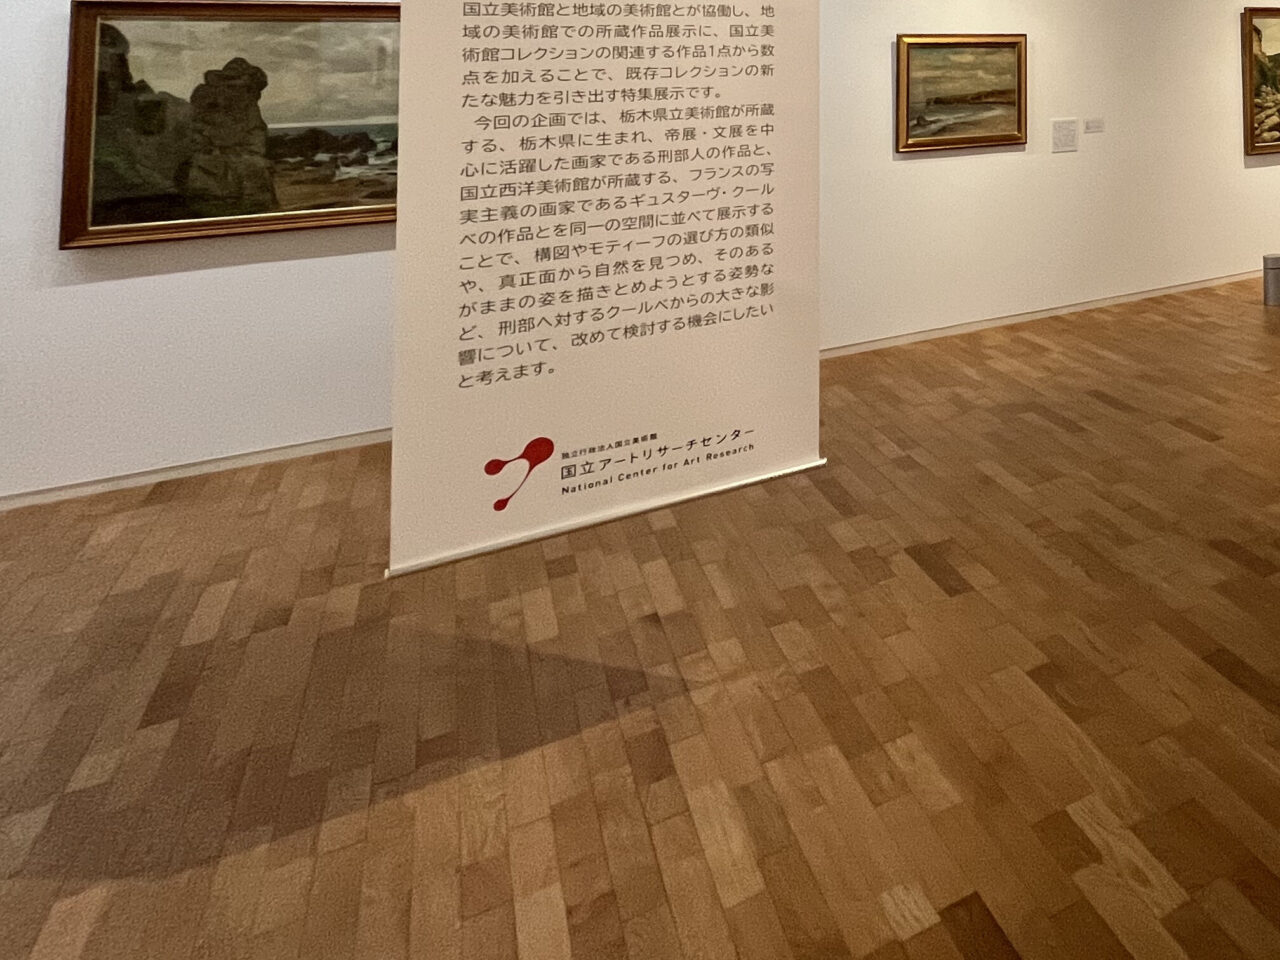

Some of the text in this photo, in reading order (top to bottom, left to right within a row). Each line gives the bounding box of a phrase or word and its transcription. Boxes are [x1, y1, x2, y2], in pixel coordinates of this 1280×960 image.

[463, 2, 775, 18] 国立美術館と地域の美術館とが協働し、地
[462, 24, 775, 39] 域の美術館での所蔵作品展示に、国立美
[462, 44, 775, 63] 術館コレクションの関連する作品1点から数
[461, 63, 775, 85] 点を加えることで、既存コレクションの新
[461, 86, 721, 108] たな魅力を引き出す特集展示です。
[474, 104, 775, 131] 今回の企画では、栃木県立美術館が所蔵
[461, 123, 775, 154] する、栃木県に生まれ、帝展・文展を中
[460, 144, 772, 176] 心に活躍した画家である刑部人の作品と、
[460, 162, 775, 201] 国立西洋美術館が所蔵する、フランスの写
[459, 203, 774, 246] ベの作品とを同一の空間に並べて展示する
[459, 222, 774, 270] ことで、構図やモティーフの選び方の類似
[459, 243, 774, 293] や、真正面から自然を見つめ、そのある
[459, 263, 774, 318] がままの姿を描きとめようとする姿勢な
[458, 304, 774, 366] 響について、改めて検討する機会にしたい
[458, 362, 556, 389] と考えます。
[561, 429, 754, 479] 国立アートリサーチセンター
[562, 443, 754, 495] National Center for Art Research
